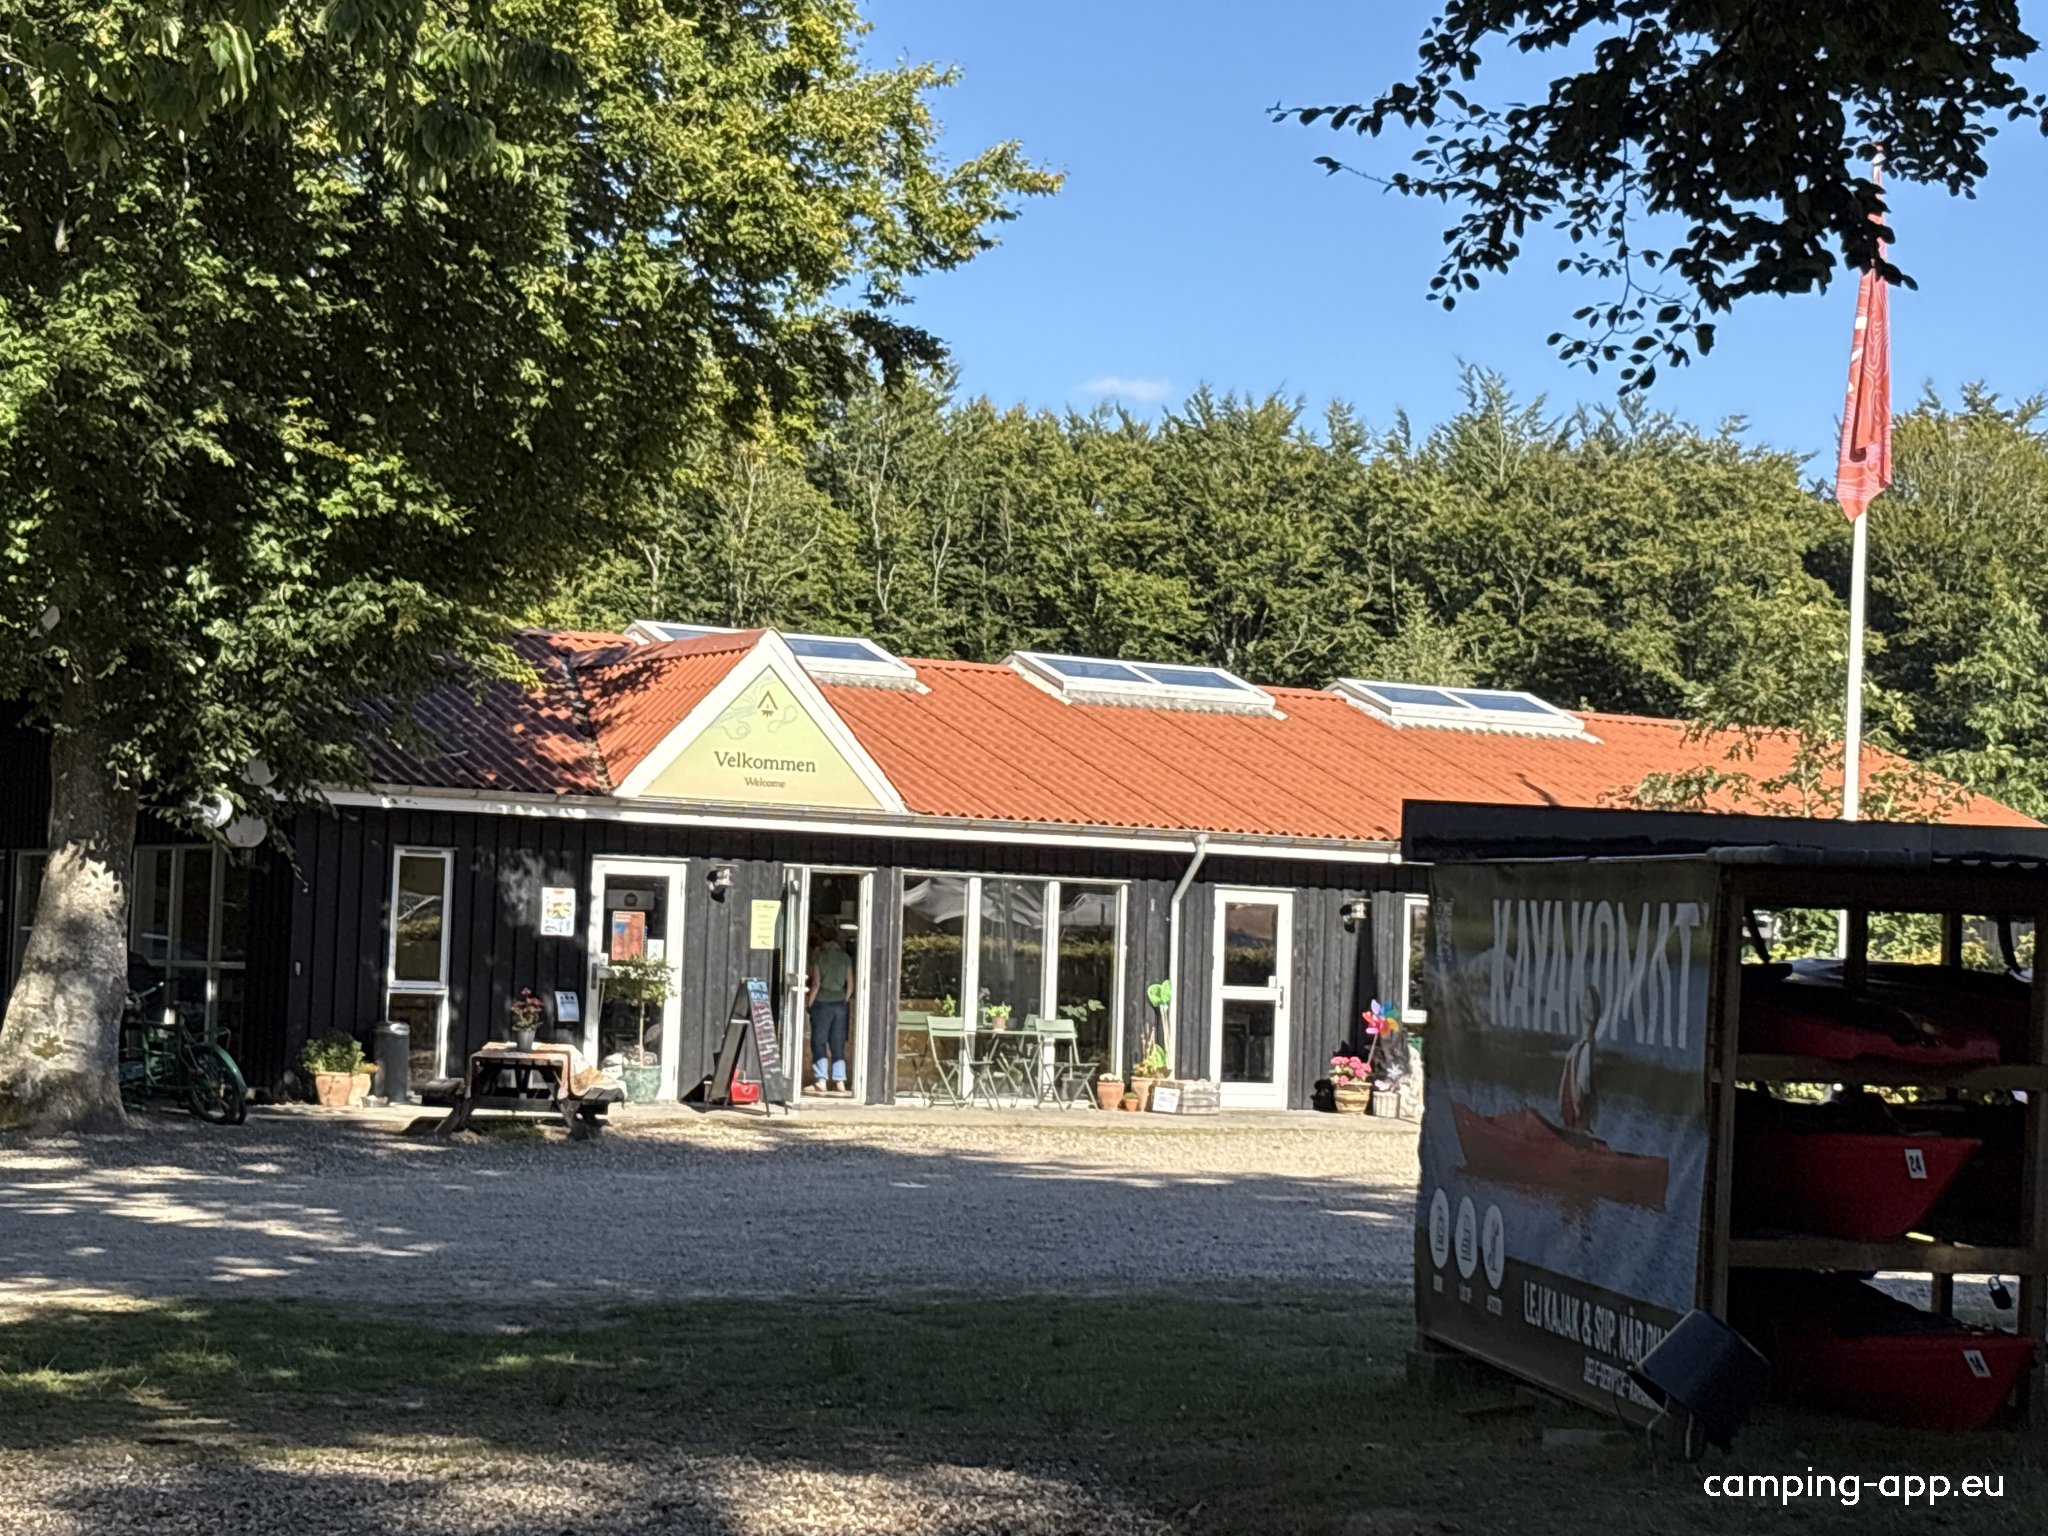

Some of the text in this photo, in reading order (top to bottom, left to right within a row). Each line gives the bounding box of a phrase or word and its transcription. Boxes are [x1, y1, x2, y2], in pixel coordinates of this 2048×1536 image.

[714, 751, 816, 773] Velkommen
[744, 776, 786, 789] Welcome
[1523, 1279, 1543, 1328] LEJ
[1543, 1286, 1582, 1343] KAJAK
[1581, 1300, 1592, 1347] &
